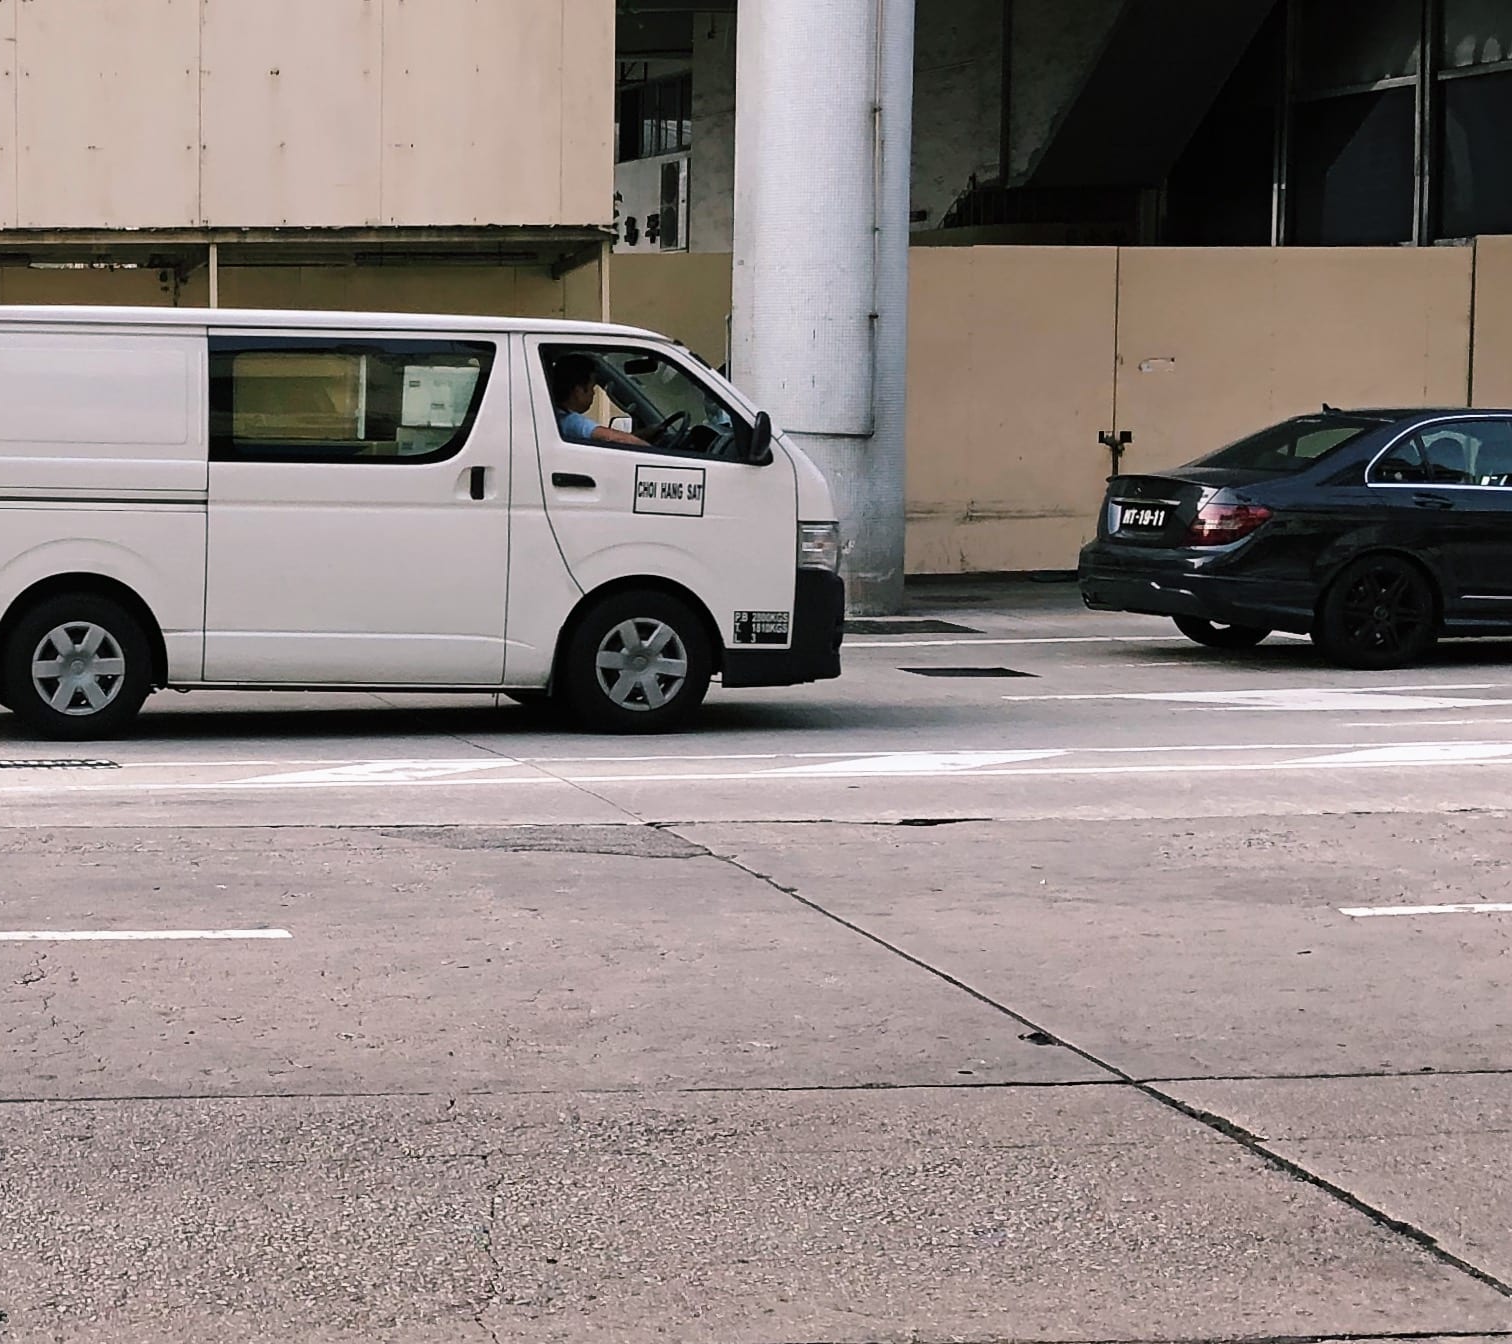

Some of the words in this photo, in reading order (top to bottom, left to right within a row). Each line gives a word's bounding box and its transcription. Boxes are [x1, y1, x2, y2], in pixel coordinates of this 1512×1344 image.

[638, 481, 656, 498] CHOI
[660, 482, 683, 500] HANG
[687, 483, 702, 501] SAT
[751, 633, 757, 643] 3
